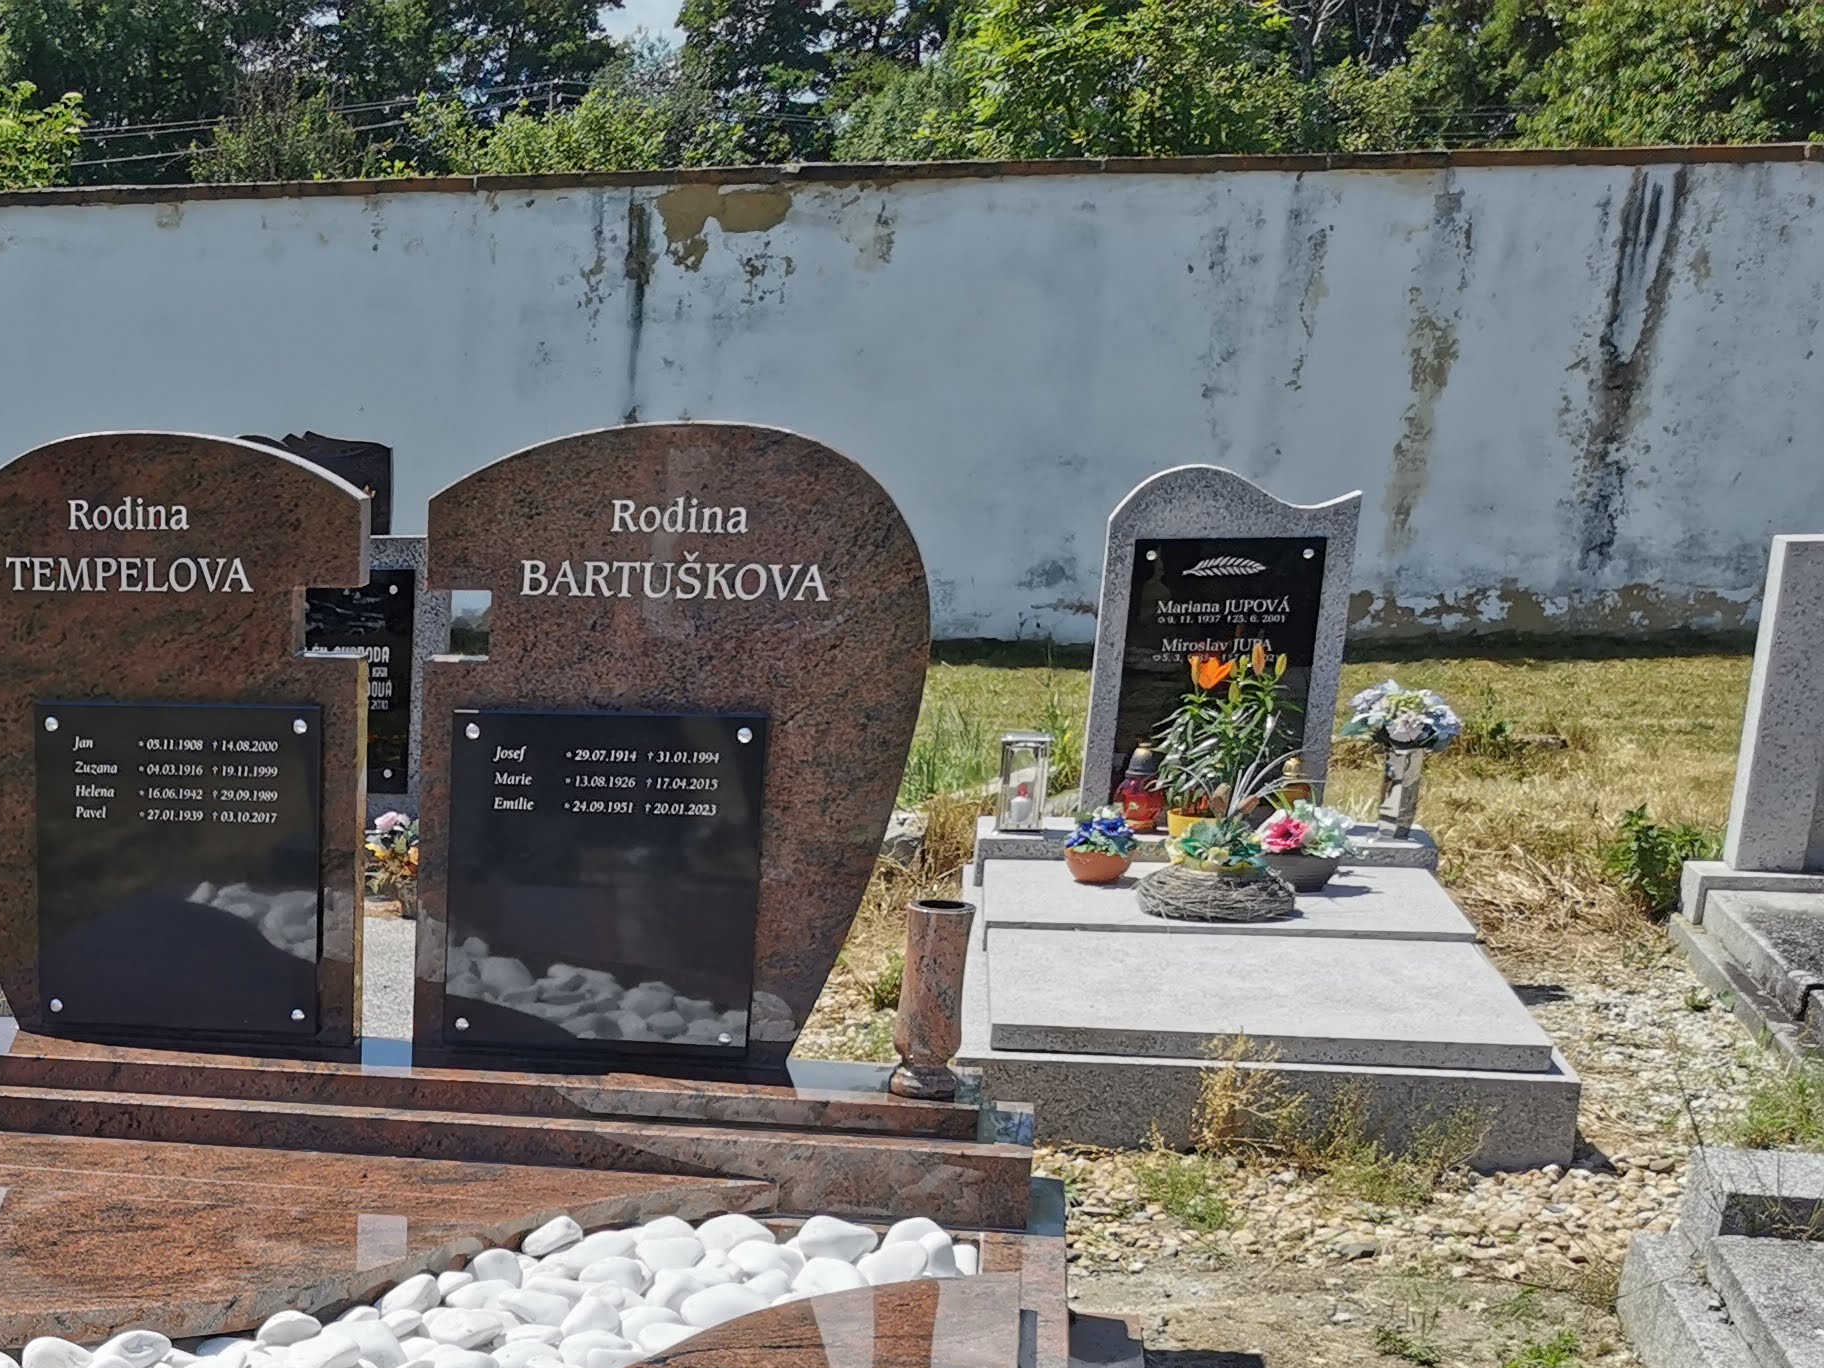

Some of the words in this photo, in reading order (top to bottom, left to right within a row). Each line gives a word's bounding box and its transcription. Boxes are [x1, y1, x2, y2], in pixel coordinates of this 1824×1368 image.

[68, 496, 190, 531] Rodina
[610, 497, 749, 534] Rodina
[5, 556, 254, 593] TEMPELOVA
[519, 550, 830, 602] BARTUŠKOVA
[1157, 600, 1220, 614] Mariana
[1223, 595, 1291, 615] JUPOVÁ
[1161, 637, 1229, 652] Miroslav
[72, 735, 94, 751] Jan
[146, 738, 204, 751] 05.11.1908
[221, 739, 279, 752] 14.08.2000
[492, 746, 527, 762] Josef
[574, 749, 638, 763] 29.07.1914
[656, 751, 720, 764] 31.01.1994
[74, 760, 118, 776] Zuzana
[146, 763, 204, 776] 04.03.1916
[221, 765, 279, 778] 19.11.1999
[494, 772, 533, 786] Marie
[575, 775, 637, 789] 13.08.1926
[656, 777, 719, 791] 17.04.2015
[75, 784, 116, 798] Helena
[147, 787, 204, 800] 16.06.1942
[220, 789, 279, 802] 29.09.1989
[75, 805, 107, 819] Pavel
[146, 809, 204, 822] 27.01.1939
[220, 811, 278, 824] 03.10.2017
[493, 796, 536, 811] Emilie
[572, 800, 634, 814] 24.09.1951
[653, 803, 718, 817] 20.01.2023
